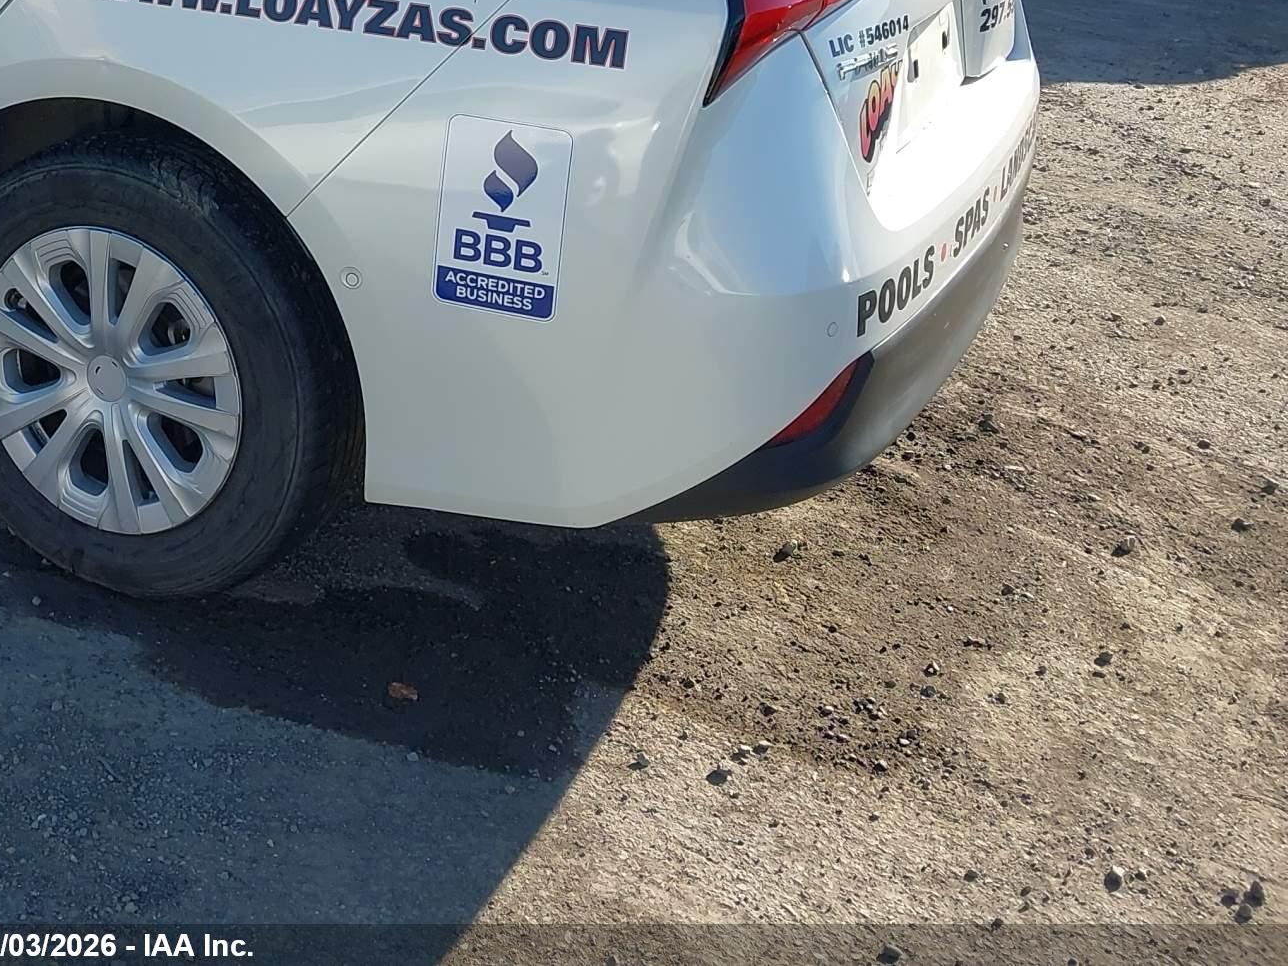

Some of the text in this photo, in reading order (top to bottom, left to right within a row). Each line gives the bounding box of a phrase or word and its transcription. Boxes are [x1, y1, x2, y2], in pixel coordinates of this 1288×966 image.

[829, 15, 910, 57] LIC #546014
[453, 228, 543, 273] BBB
[857, 245, 935, 337] POOLS
[953, 187, 990, 258] SPAS
[445, 270, 545, 300] ACCREDITED
[456, 285, 532, 310] BUSINESS
